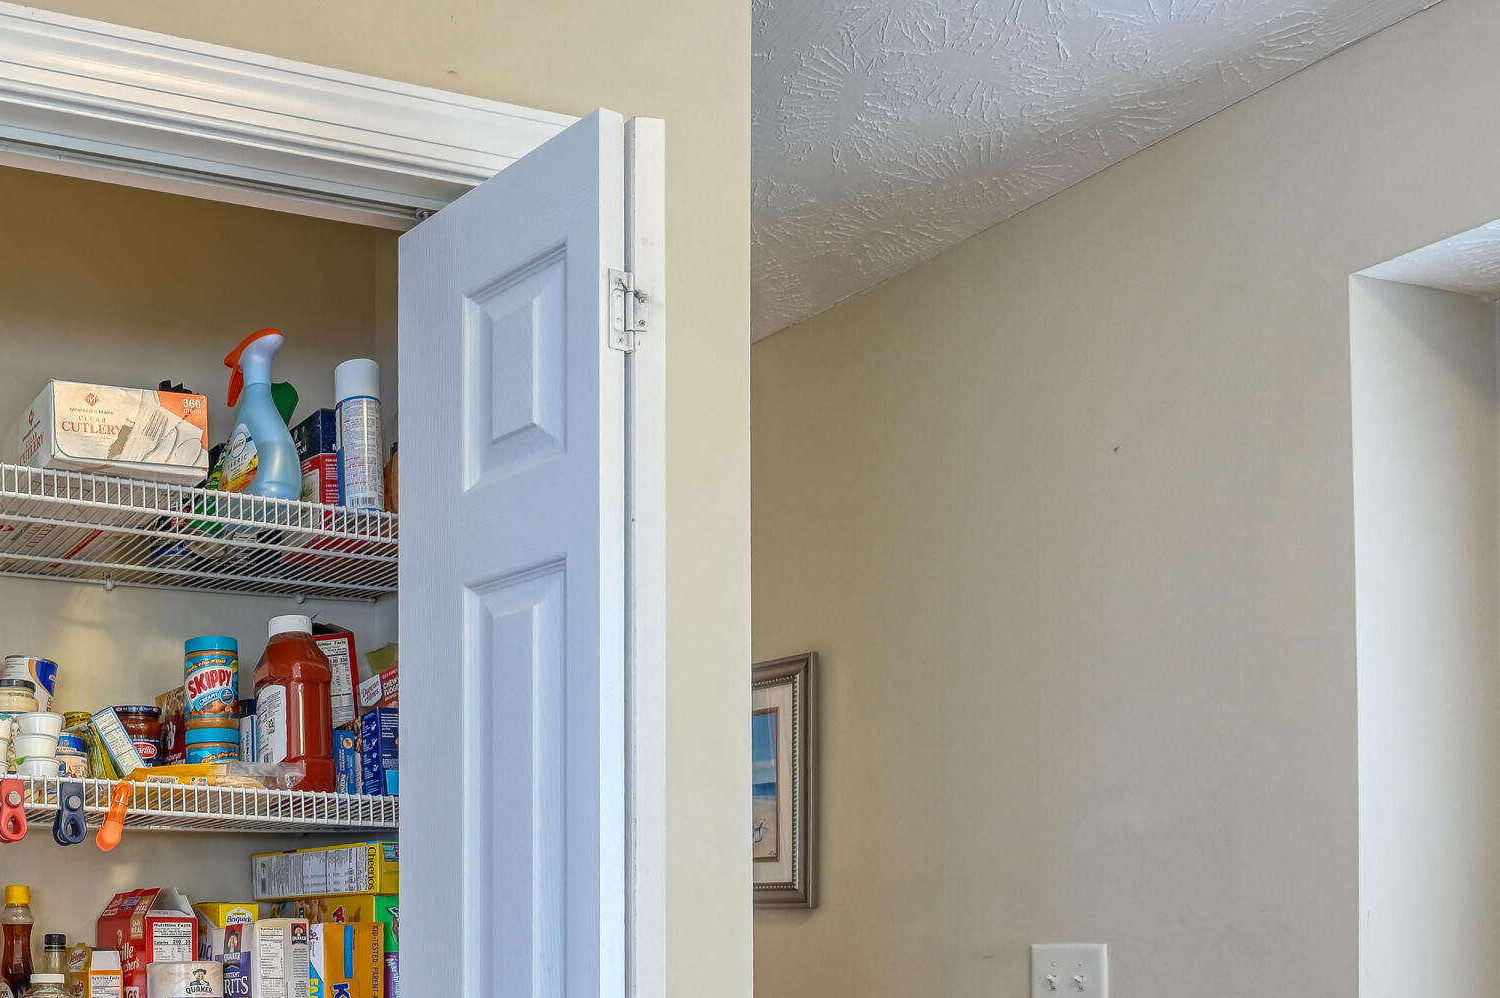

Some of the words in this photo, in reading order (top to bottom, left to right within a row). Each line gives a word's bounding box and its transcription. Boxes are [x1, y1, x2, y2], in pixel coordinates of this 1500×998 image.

[183, 398, 201, 408] 360
[61, 421, 121, 436] CUTLERY
[188, 669, 232, 700] SKIPPY
[363, 680, 379, 698] Duncan
[138, 746, 155, 754] arilla
[367, 847, 376, 890] Cheerios
[224, 953, 240, 961] QUAKER
[224, 976, 248, 996] RITS
